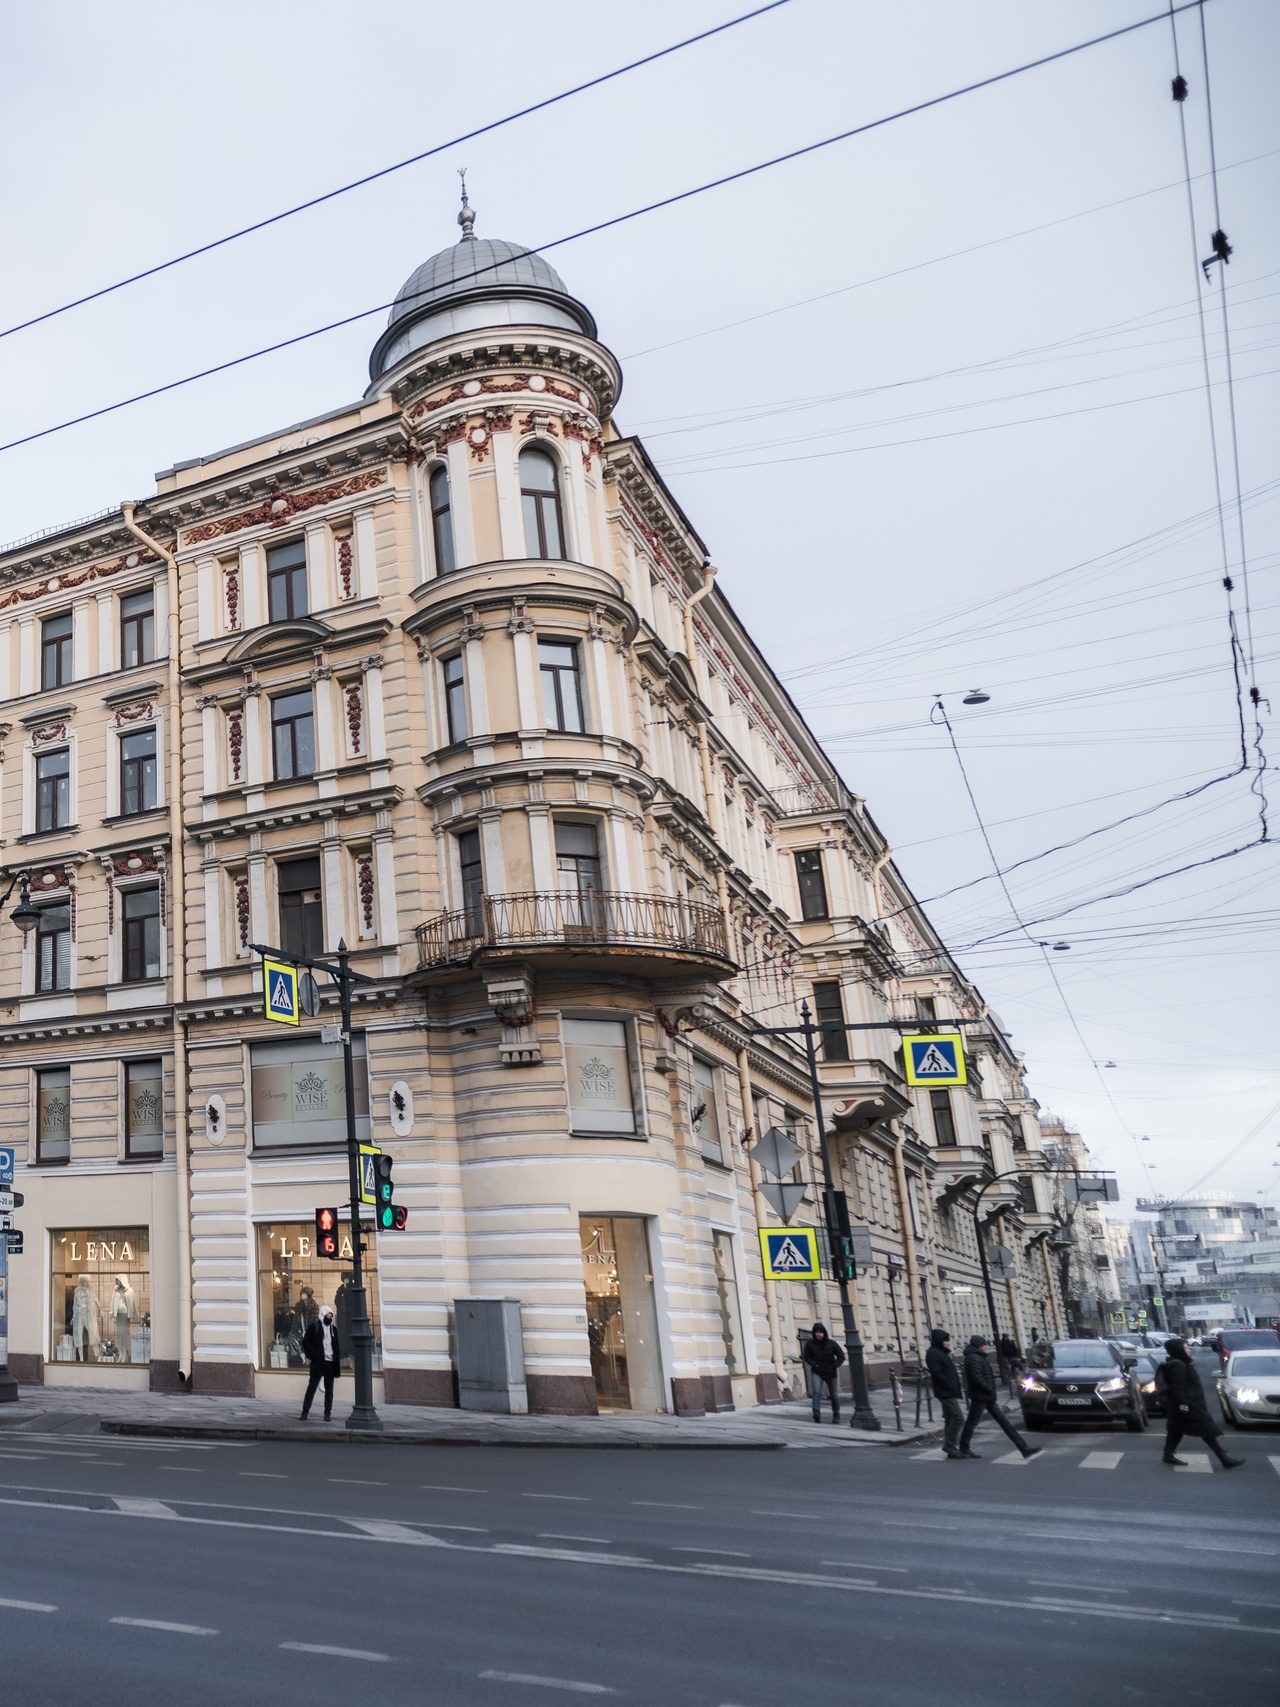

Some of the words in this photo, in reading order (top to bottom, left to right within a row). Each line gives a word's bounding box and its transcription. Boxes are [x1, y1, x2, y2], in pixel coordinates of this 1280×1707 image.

[580, 1080, 616, 1092] WISE
[295, 1093, 328, 1104] WISE
[132, 1109, 161, 1119] WISE
[43, 1115, 69, 1126] WISE
[71, 1241, 134, 1261] LENA
[280, 1236, 354, 1257] LEA
[581, 1254, 617, 1265] ENA
